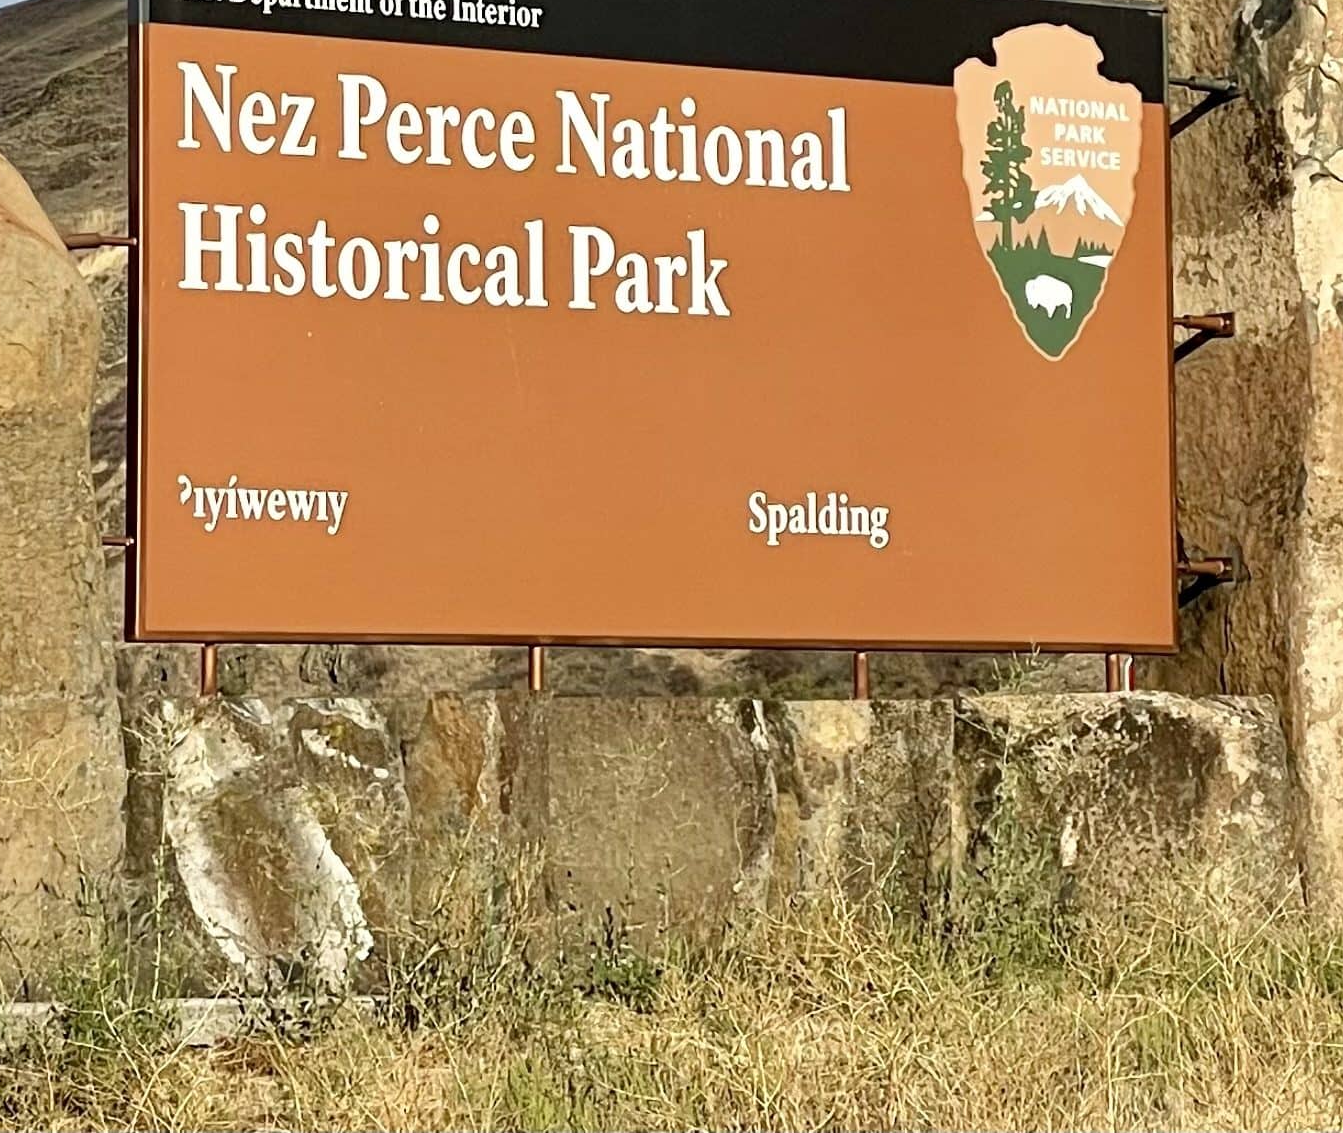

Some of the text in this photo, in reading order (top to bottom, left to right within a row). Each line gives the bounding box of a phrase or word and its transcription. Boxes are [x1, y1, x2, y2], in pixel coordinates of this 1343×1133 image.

[177, 61, 851, 192] Nez Perce National
[1029, 96, 1129, 122] NATIONAL
[1054, 122, 1106, 144] PARK
[1040, 146, 1121, 171] SERVICE
[178, 202, 731, 316] Historical Park
[748, 491, 889, 549] Spalding
